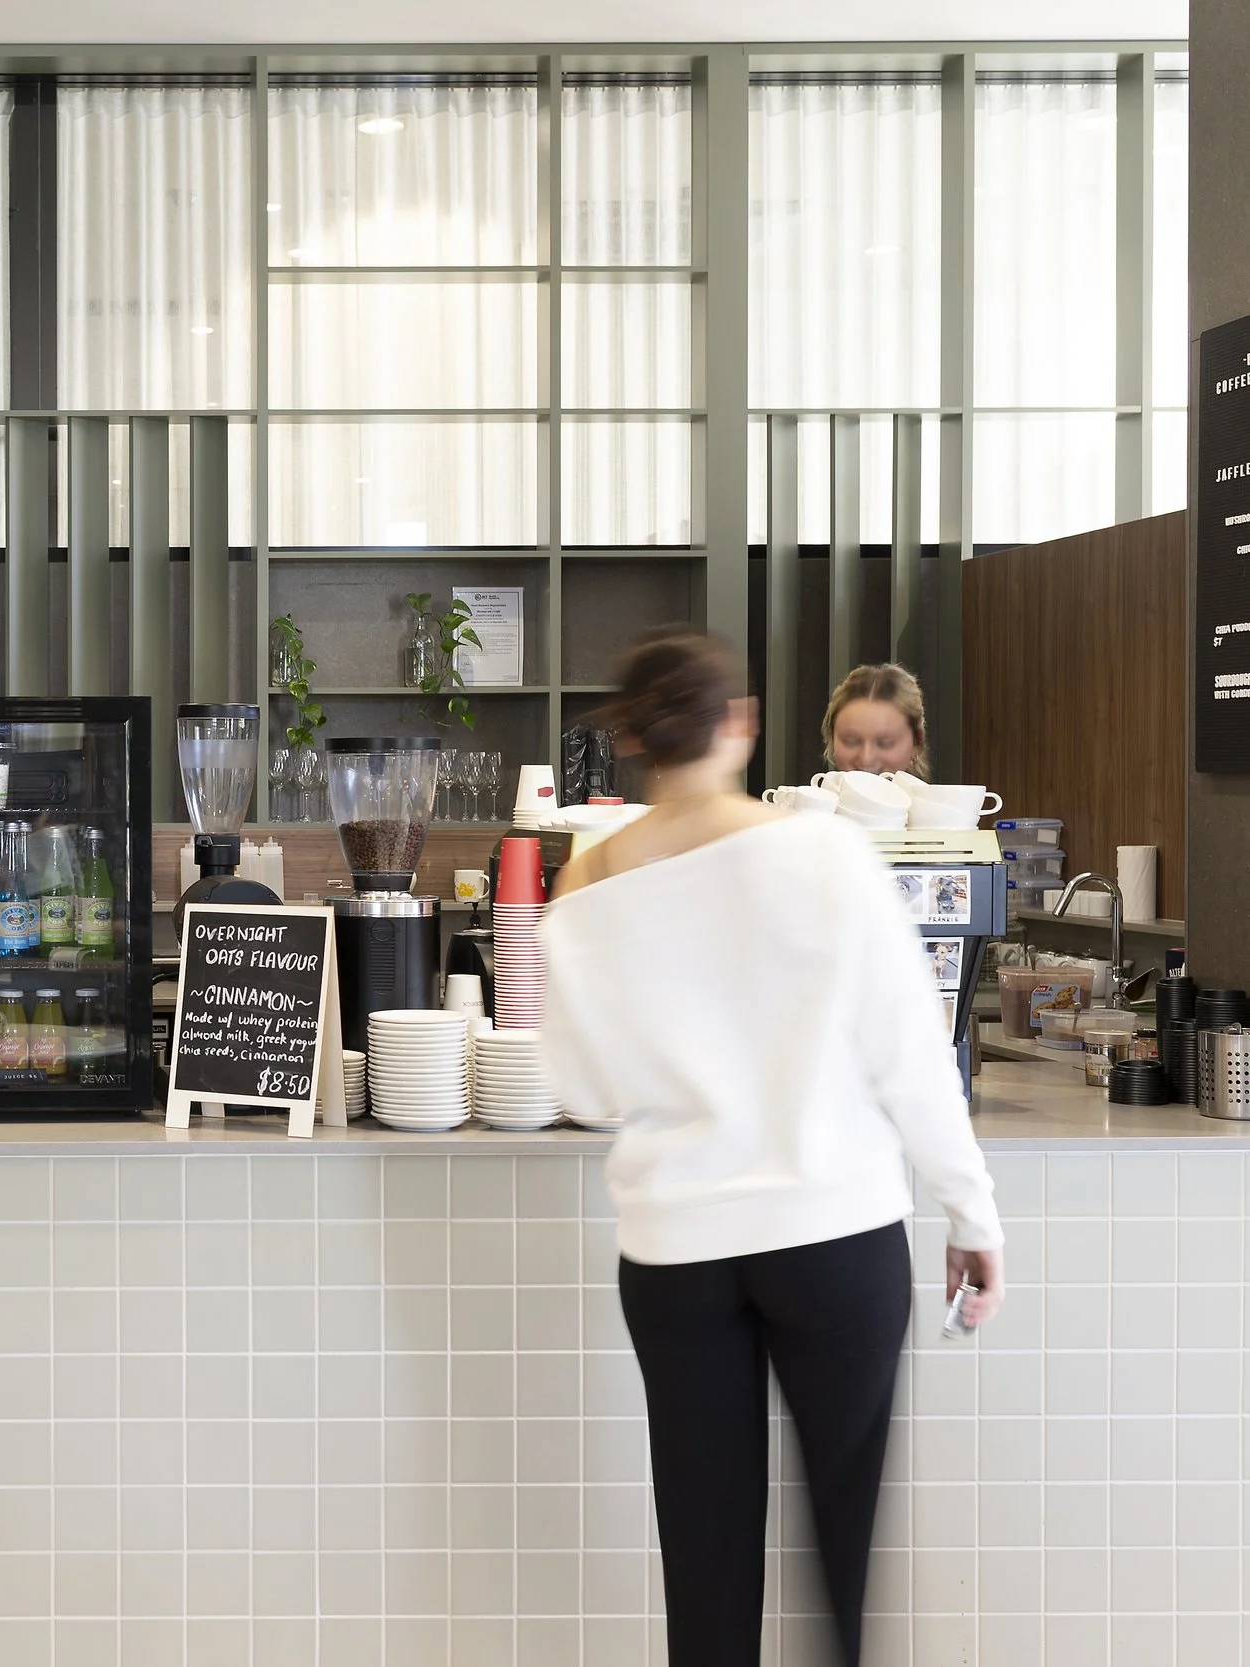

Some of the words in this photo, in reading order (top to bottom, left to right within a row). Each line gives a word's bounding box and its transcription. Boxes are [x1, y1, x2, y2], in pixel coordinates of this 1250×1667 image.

[195, 924, 288, 943] OVERNIGHT
[205, 948, 244, 966] OATS
[250, 950, 318, 971] FLAVOUR
[185, 1011, 213, 1024] Made
[238, 1014, 272, 1034] whey
[182, 1028, 223, 1041] almond
[256, 1032, 287, 1049] greek
[179, 1044, 201, 1056] chia
